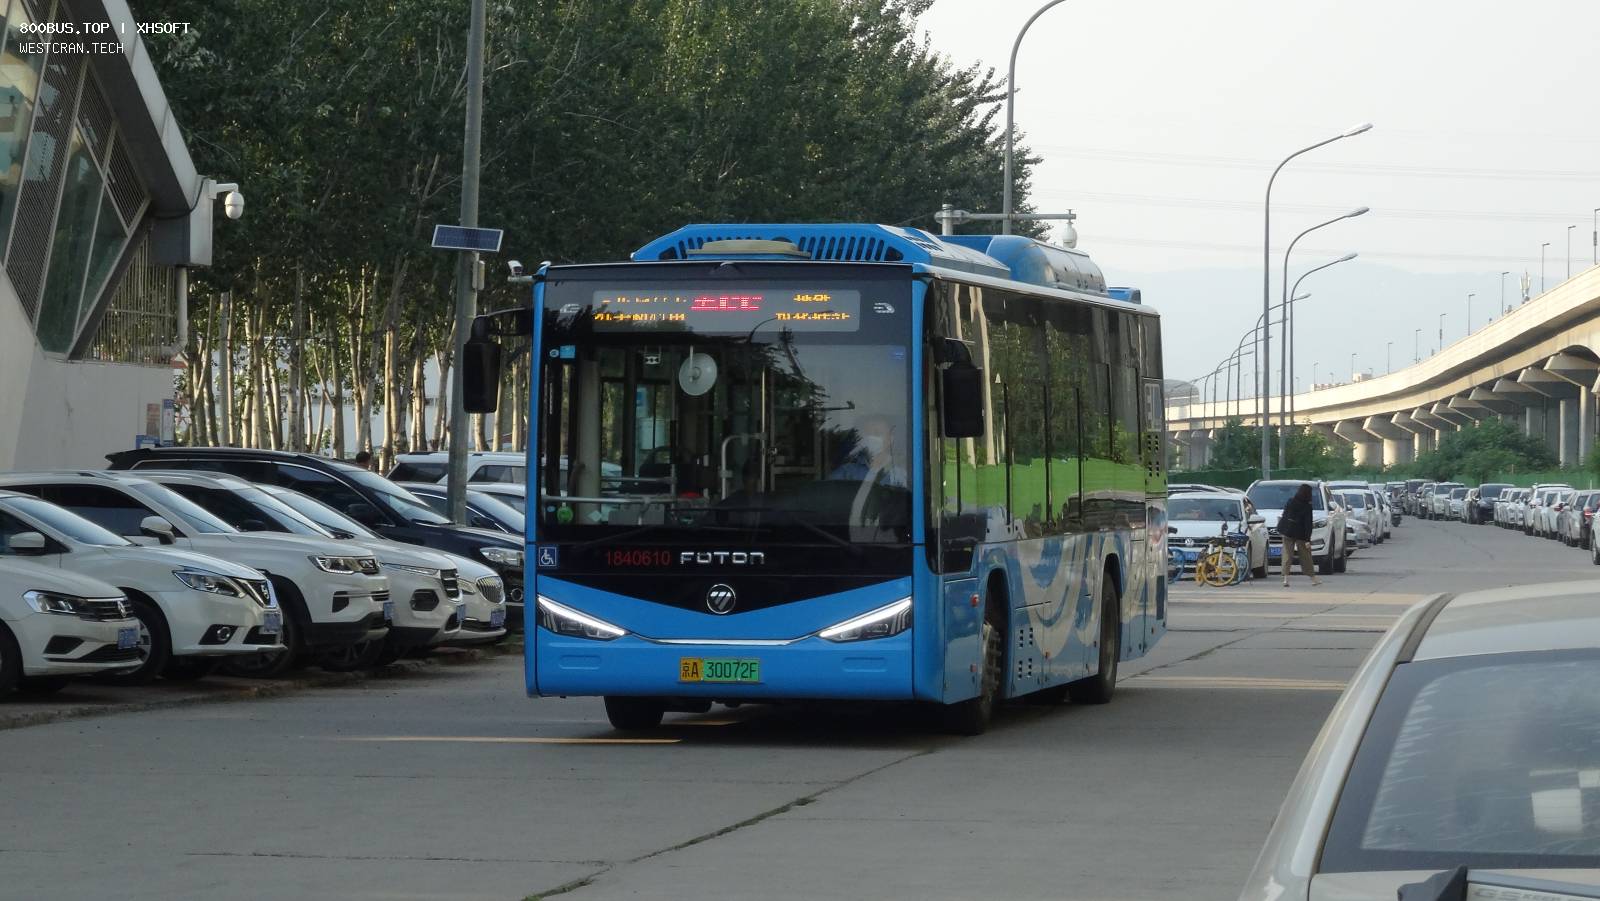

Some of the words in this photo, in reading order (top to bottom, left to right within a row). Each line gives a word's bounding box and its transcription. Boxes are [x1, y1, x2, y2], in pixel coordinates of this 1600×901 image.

[606, 550, 671, 566] 1840610
[679, 551, 766, 565] FOTON
[706, 661, 758, 678] 30072F
